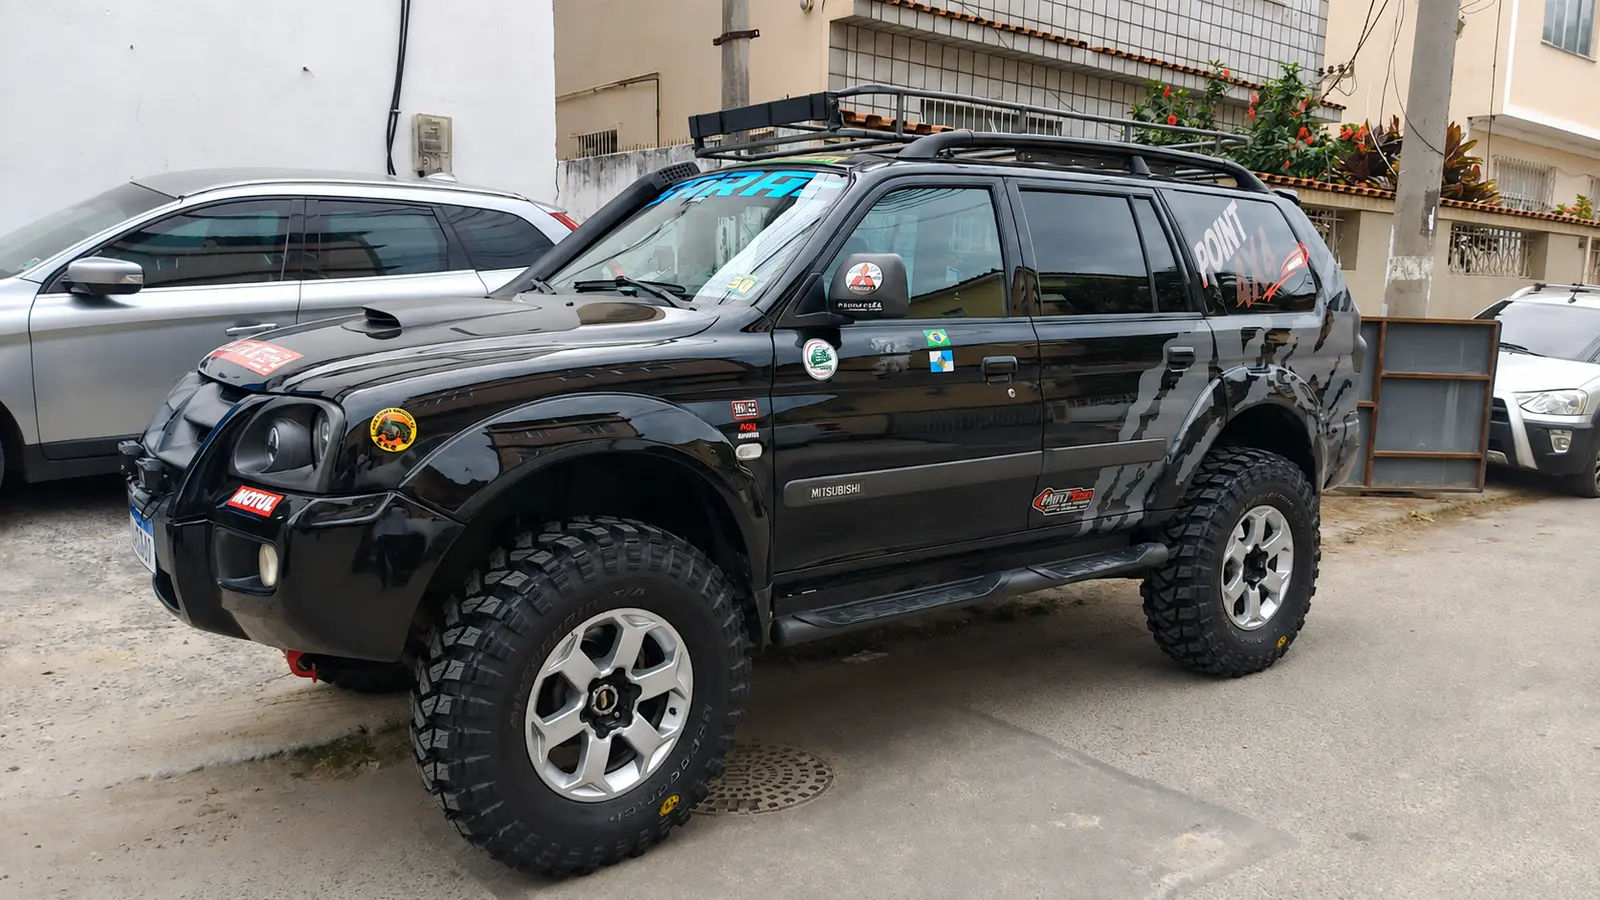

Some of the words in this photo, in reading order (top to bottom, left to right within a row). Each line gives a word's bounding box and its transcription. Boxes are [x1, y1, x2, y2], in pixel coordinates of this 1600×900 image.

[1194, 198, 1247, 289] POINT
[231, 489, 277, 512] MOTUL
[811, 483, 861, 498] MITSUBISHI
